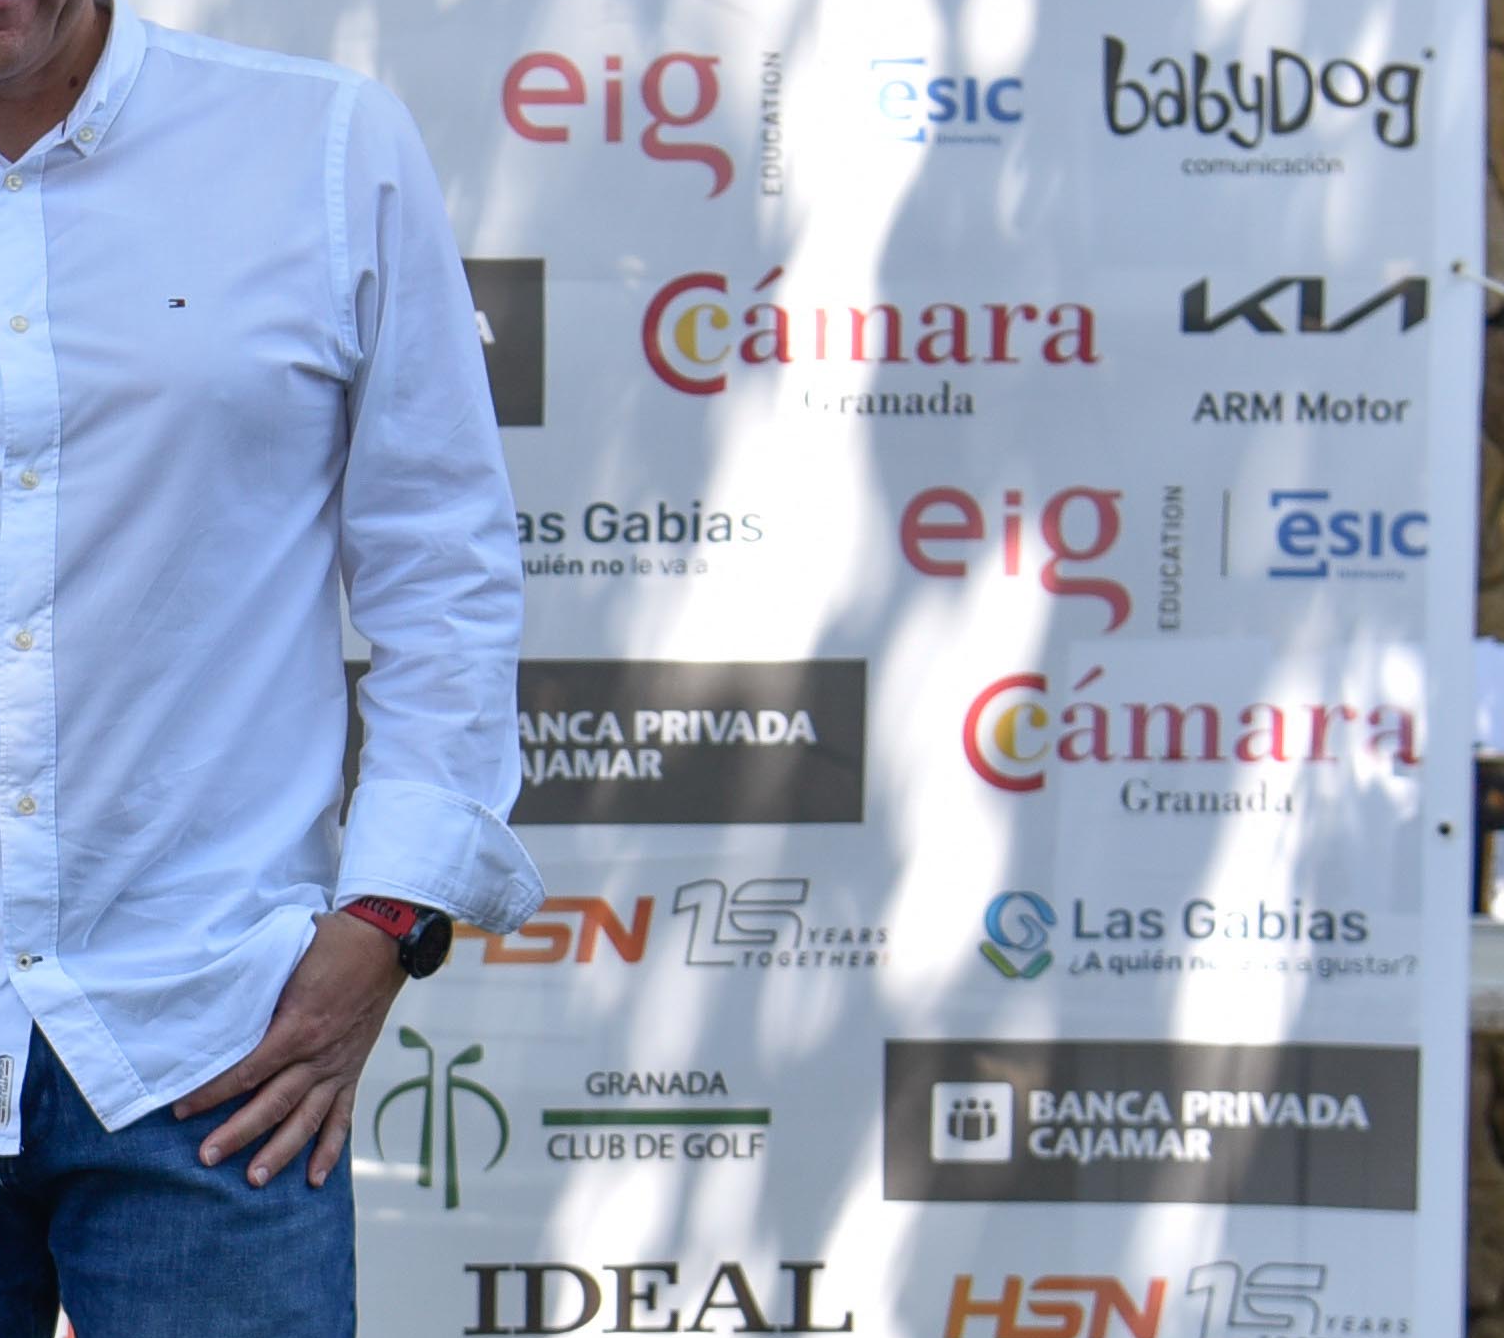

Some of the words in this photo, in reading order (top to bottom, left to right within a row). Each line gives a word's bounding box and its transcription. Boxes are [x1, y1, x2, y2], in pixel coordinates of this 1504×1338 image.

[1102, 33, 1421, 150] babyDog
[501, 50, 736, 201] eig
[760, 51, 782, 197] EDUCATION
[642, 265, 1103, 397] Cámara
[1193, 392, 1282, 424] ARM
[1296, 392, 1412, 424] Motor
[516, 510, 566, 544] as
[583, 501, 764, 544] Gabias
[523, 553, 585, 576] uién
[590, 561, 625, 576] no
[898, 485, 1132, 635] eig
[1158, 483, 1183, 634] EDUCATION
[518, 711, 624, 745] ANCA
[633, 710, 817, 746] PRIVADA
[961, 665, 1422, 793] Cámara
[520, 749, 664, 787] AJAMAR
[1120, 779, 1296, 816] Granada
[1073, 899, 1165, 942] Las
[1182, 898, 1369, 943] Gabias
[584, 1070, 728, 1096] GRANADA
[1028, 1090, 1171, 1125] BANCA
[1180, 1090, 1370, 1130] PRIVADA
[546, 1131, 626, 1161] CLUB
[635, 1131, 676, 1161] DE
[681, 1131, 766, 1161] GOLF
[1028, 1127, 1212, 1165] CAJAMAR
[461, 1261, 854, 1337] IDEAL
